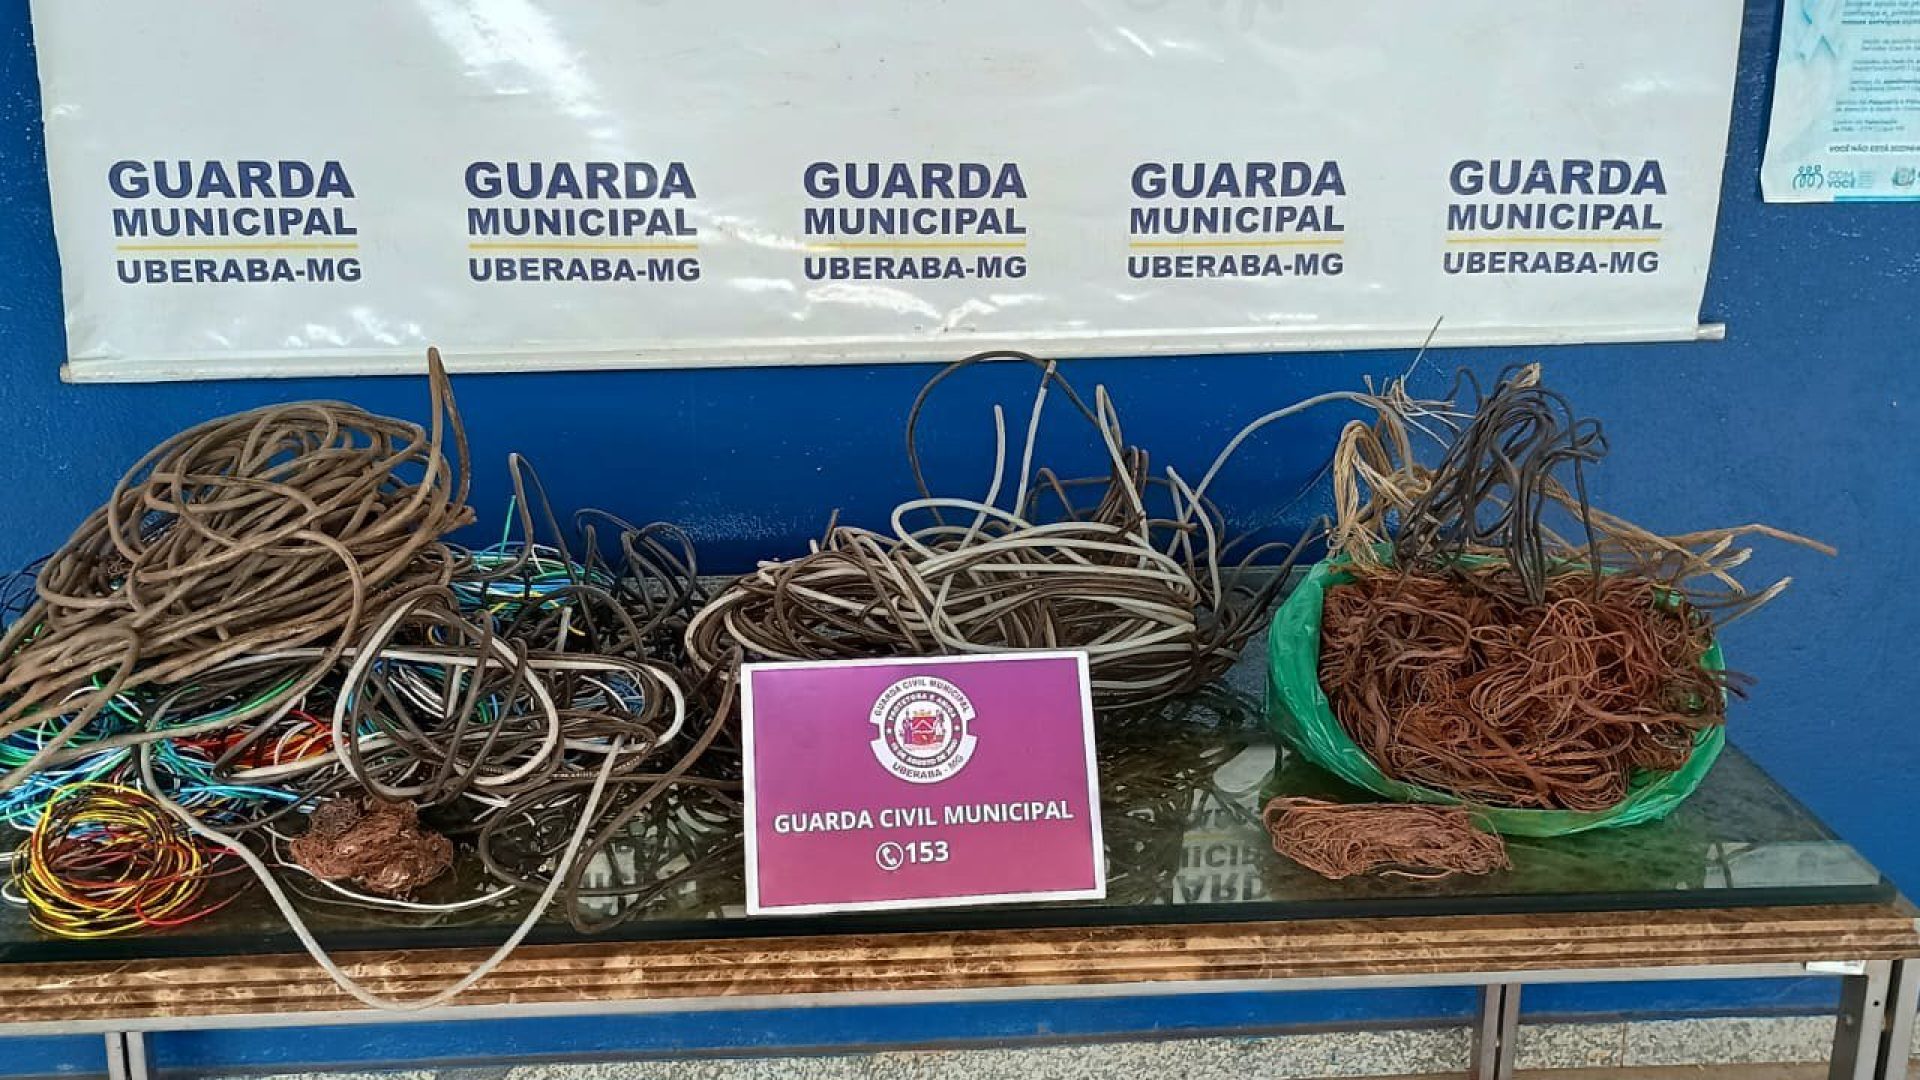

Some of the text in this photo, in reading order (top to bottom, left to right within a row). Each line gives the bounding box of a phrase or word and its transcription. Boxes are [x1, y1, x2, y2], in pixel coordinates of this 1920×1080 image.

[108, 160, 353, 198] GUARDA
[465, 162, 694, 199] GUARDA
[804, 162, 1024, 198] GUARDA
[1131, 161, 1344, 198] GUARDA
[1450, 159, 1667, 195] GUARDA
[112, 207, 357, 237] MUNICIPAL
[468, 208, 695, 236] MUNICIPAL
[805, 208, 1023, 234] MUNICIPAL
[1131, 205, 1344, 234] MUNICIPAL
[1448, 204, 1662, 230] MUNICIPAL
[117, 257, 361, 283] UBERABA-MG
[469, 258, 699, 282] UBERABA-MG
[805, 256, 1026, 280] UBERABA-MG
[1129, 254, 1343, 279] UBERABA-MG
[1444, 250, 1658, 274] UBERABA-MG
[875, 679, 970, 716] GUARDA CIVIL MUNICIPAL
[892, 761, 943, 780] UBERABA
[774, 800, 1074, 833] GUARDA CIVIL MUNICIPAL
[905, 841, 949, 863] 153
